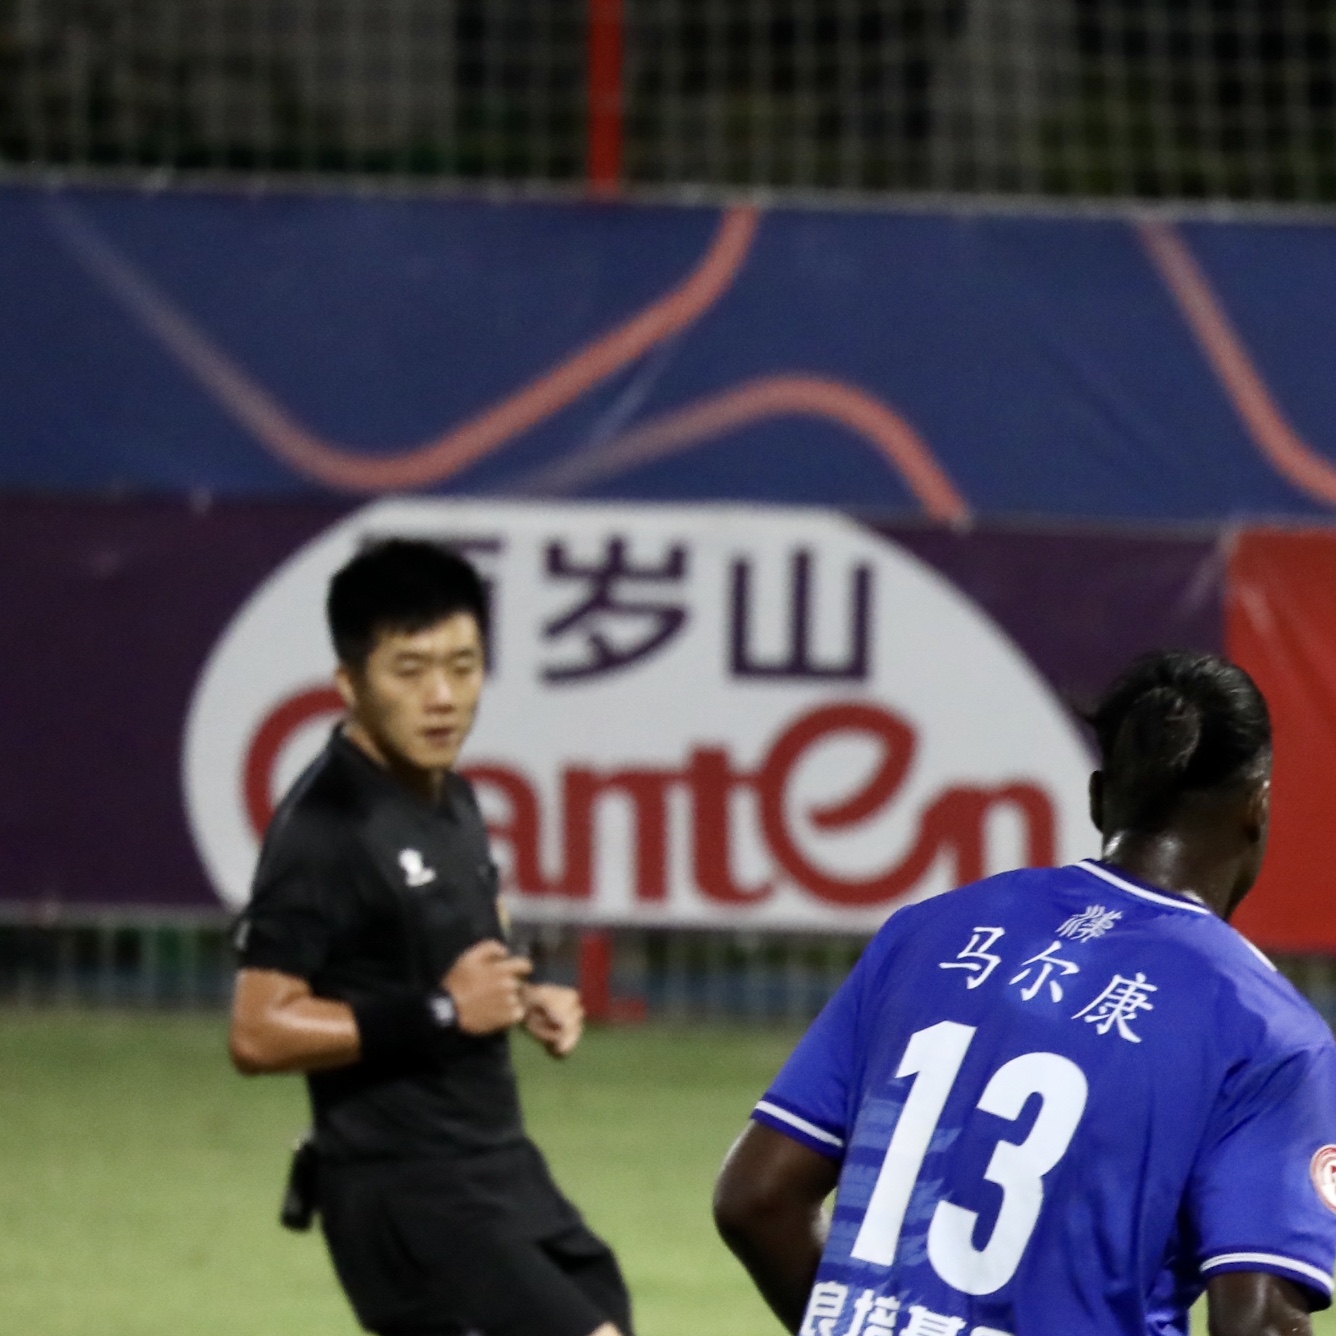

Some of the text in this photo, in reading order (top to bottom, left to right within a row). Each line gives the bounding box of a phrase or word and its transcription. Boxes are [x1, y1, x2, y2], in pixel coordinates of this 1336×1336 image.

[362, 532, 870, 684] 岁山
[938, 926, 1159, 1043] 马尔康
[850, 1019, 1089, 1296] 13
